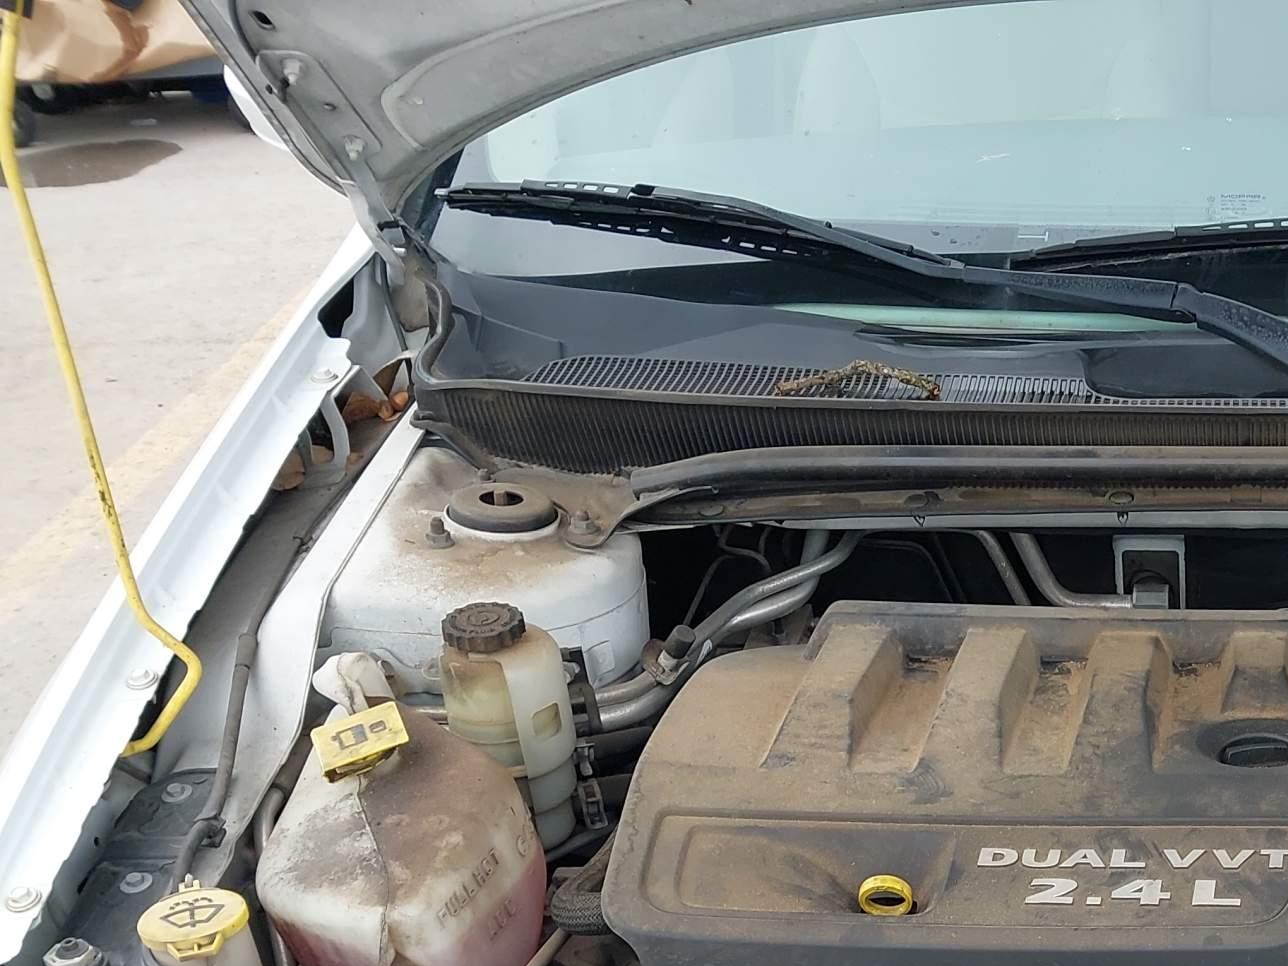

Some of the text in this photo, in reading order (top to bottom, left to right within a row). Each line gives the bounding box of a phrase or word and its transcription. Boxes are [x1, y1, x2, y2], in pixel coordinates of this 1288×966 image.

[977, 847, 1147, 868] DUAL
[1024, 878, 1242, 907] 2.4 L
